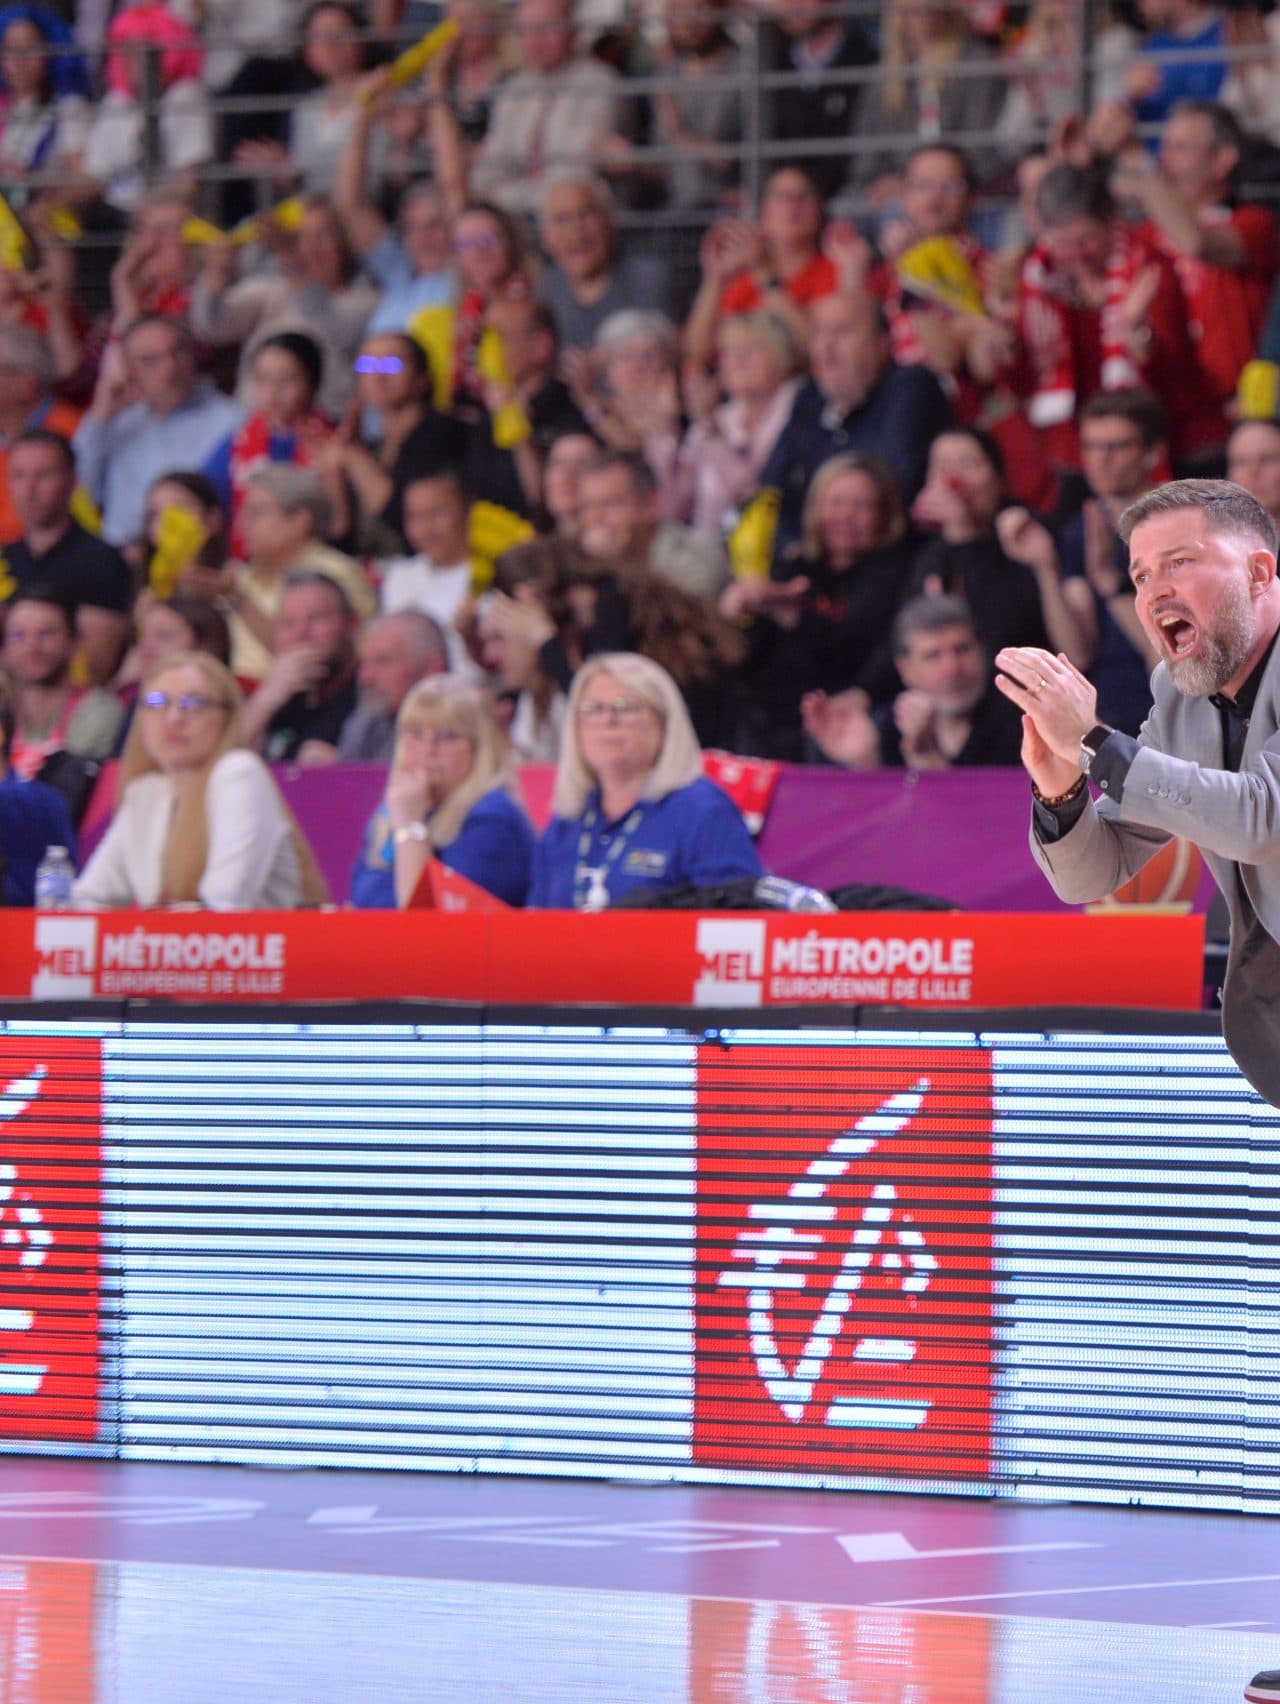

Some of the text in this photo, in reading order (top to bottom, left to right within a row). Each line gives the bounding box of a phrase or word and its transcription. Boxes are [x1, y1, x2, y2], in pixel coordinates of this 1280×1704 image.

[102, 926, 285, 969] MÉTROPOLE
[772, 929, 974, 974] MÉTROPOLE
[212, 972, 234, 993] DE
[238, 973, 282, 993] LILLE
[771, 974, 971, 1000] EUROPÉENNE DE LILLE
